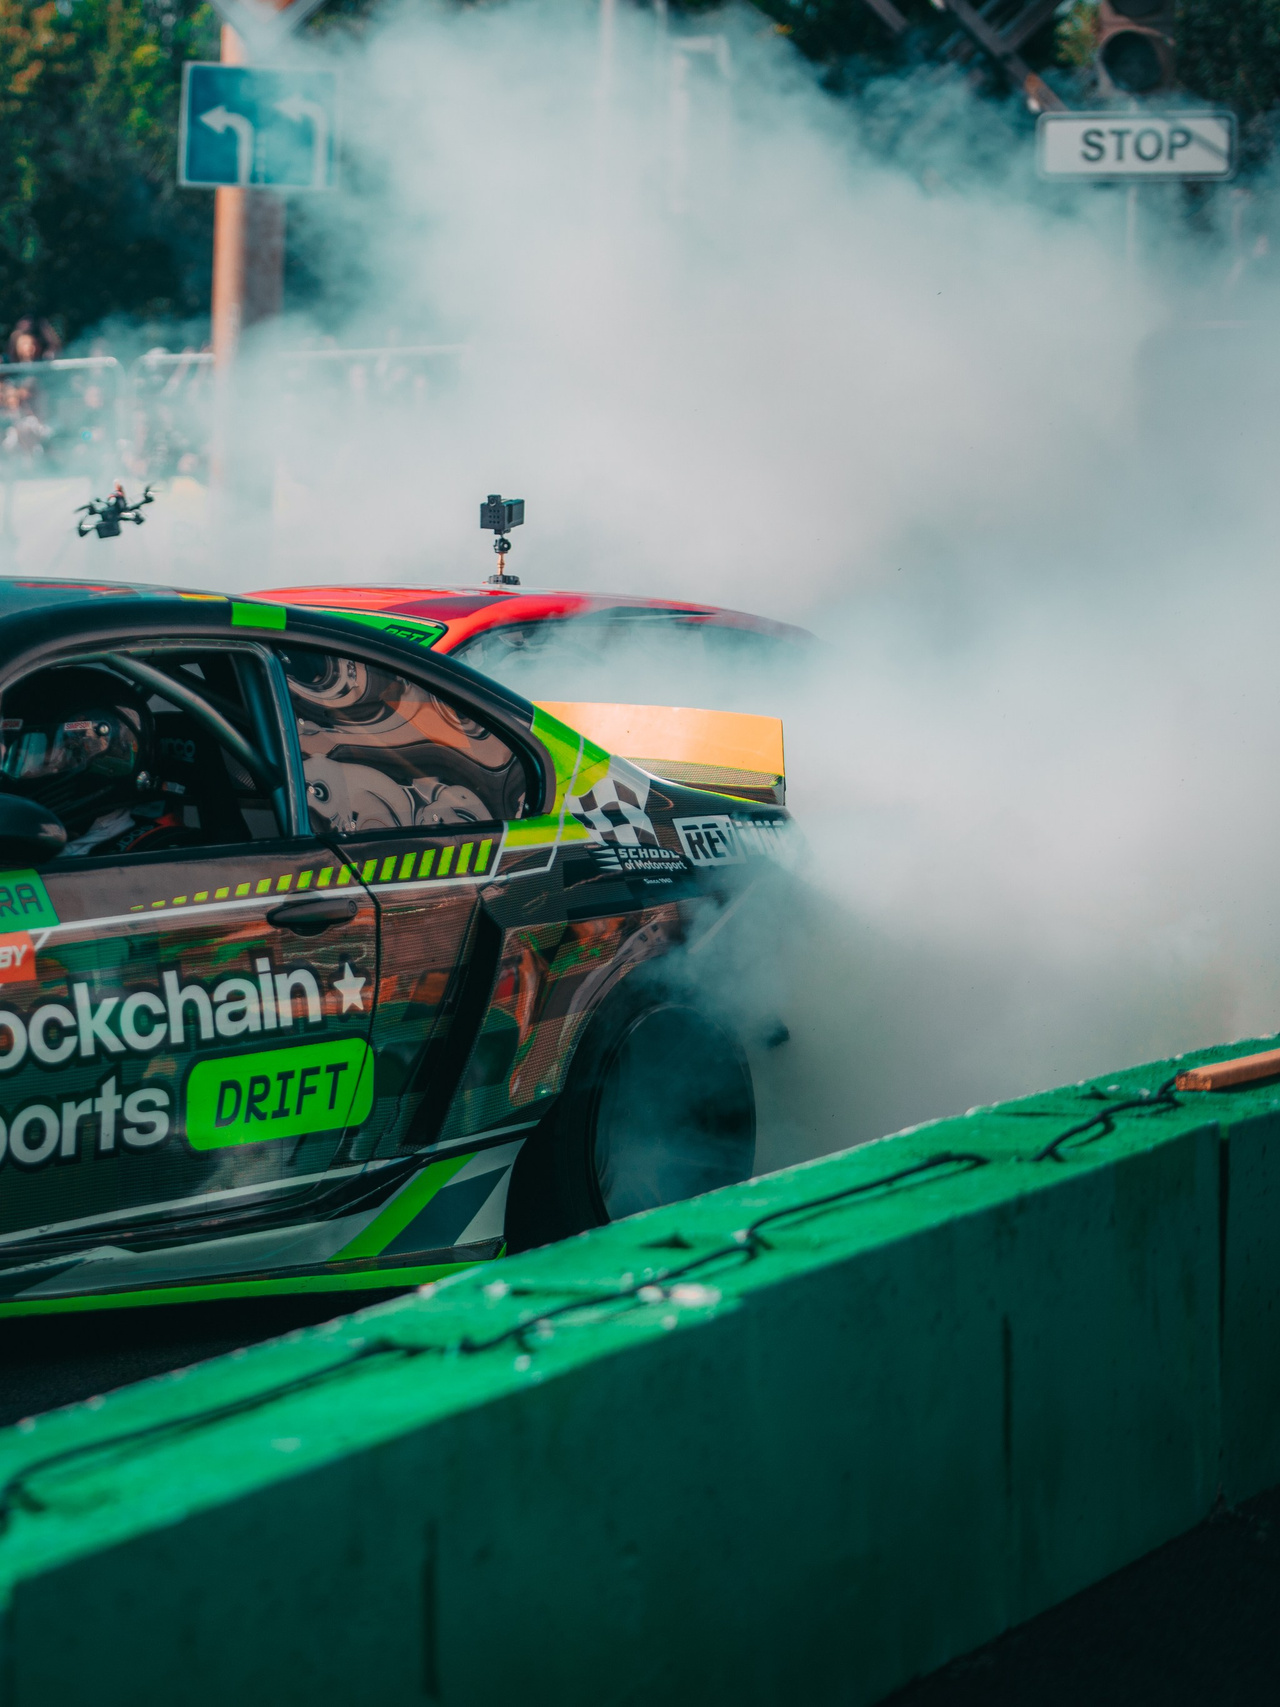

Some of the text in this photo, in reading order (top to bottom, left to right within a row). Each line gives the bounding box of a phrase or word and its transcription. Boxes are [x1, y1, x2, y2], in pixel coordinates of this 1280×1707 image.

[1081, 127, 1193, 162] STOP
[617, 847, 680, 859] SCHOOL
[624, 859, 688, 872] of Motorsport
[213, 1061, 349, 1129] DRIFT
